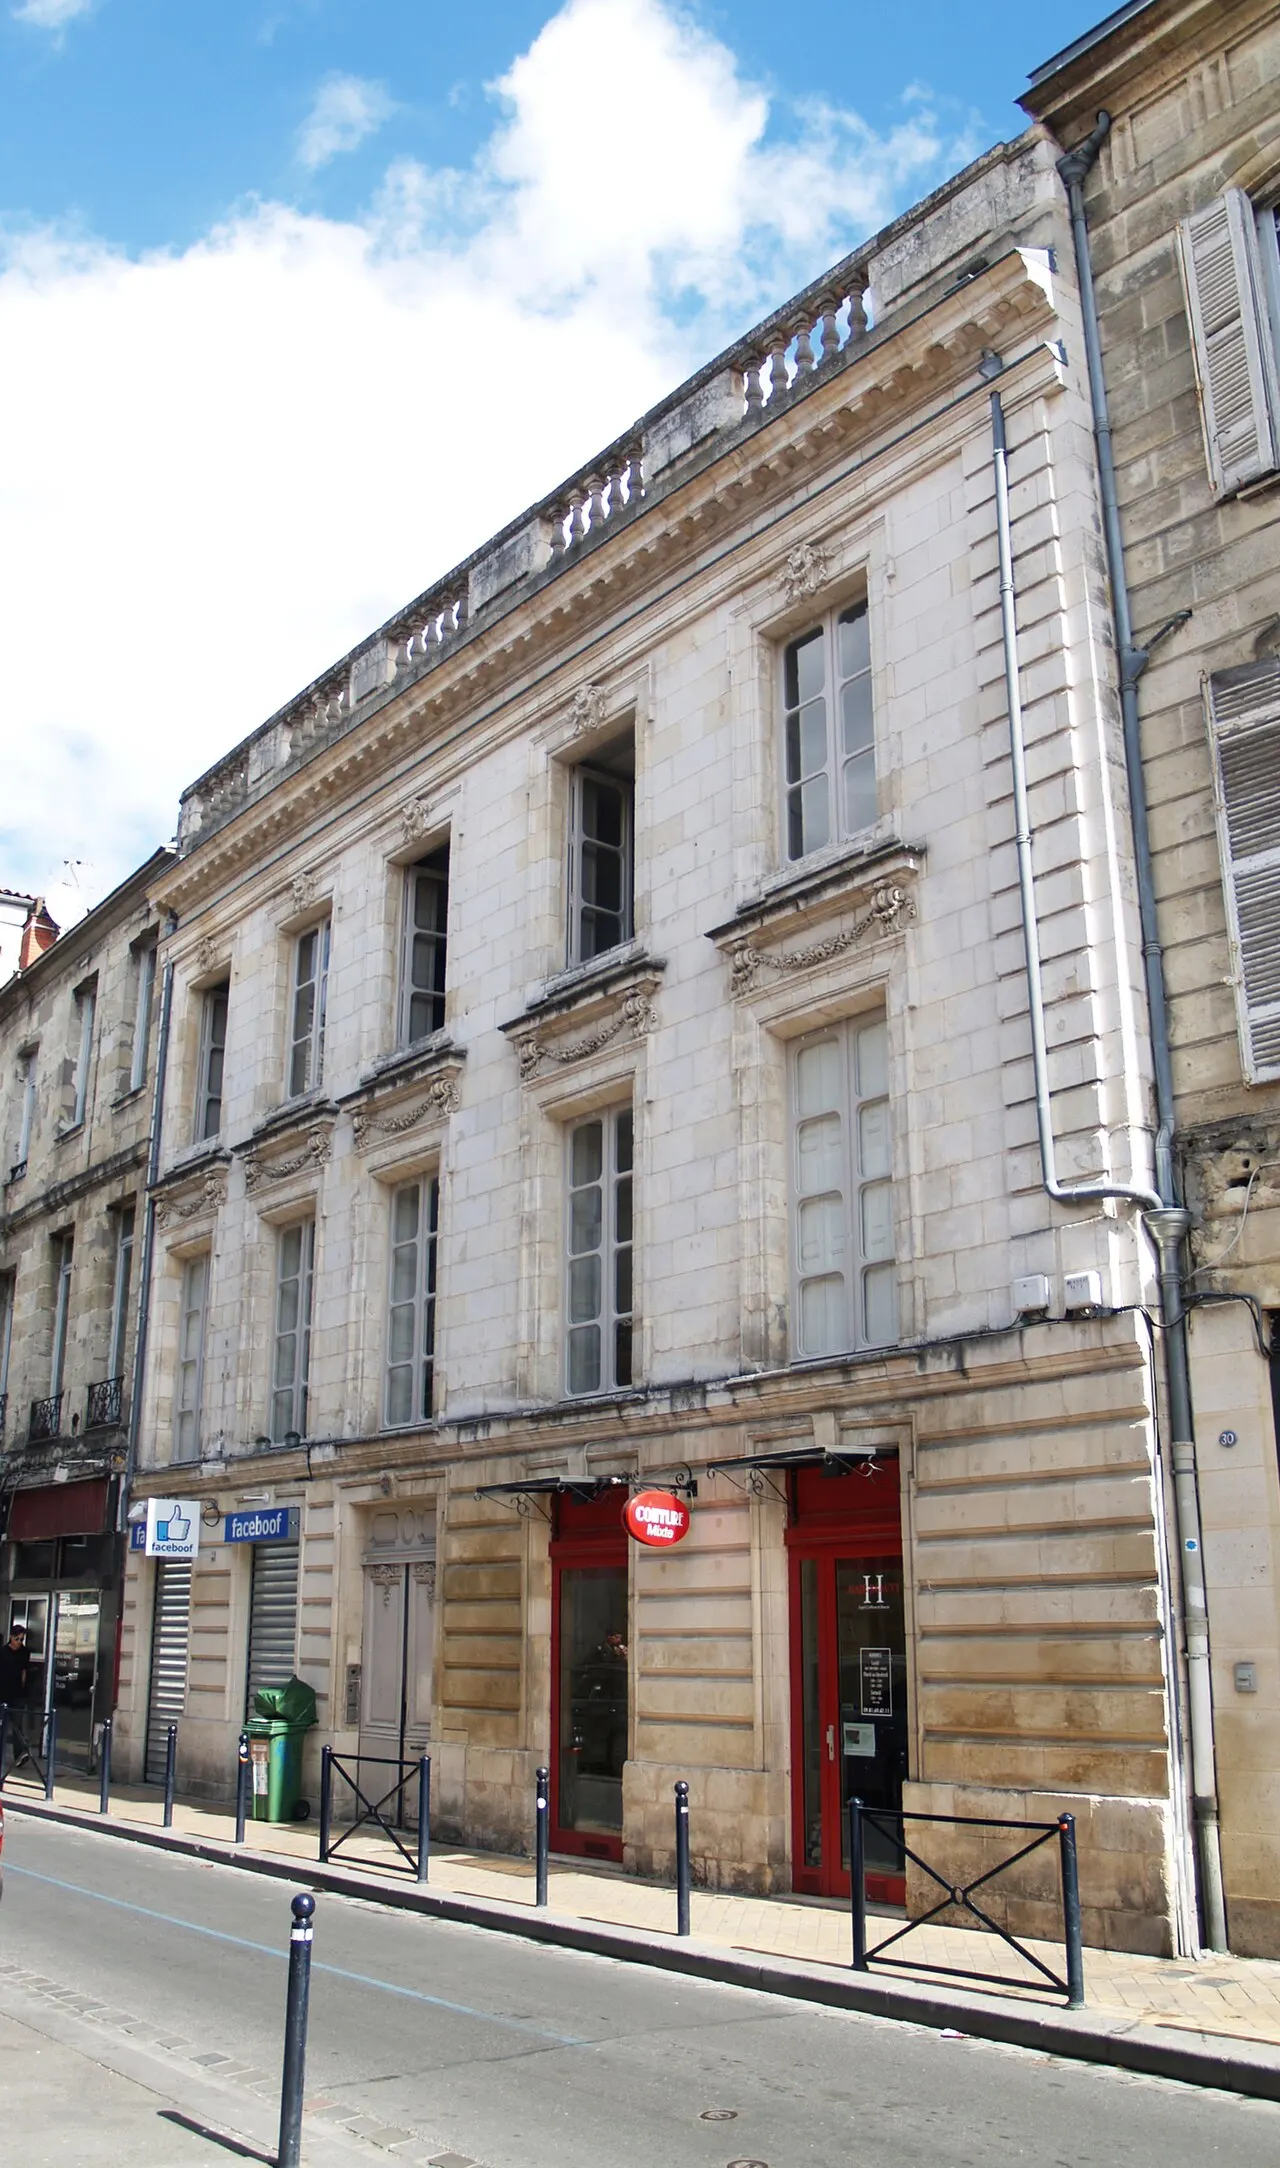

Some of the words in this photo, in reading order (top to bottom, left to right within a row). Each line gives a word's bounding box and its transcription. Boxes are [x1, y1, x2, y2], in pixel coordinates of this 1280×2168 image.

[1221, 1433, 1234, 1445] 30
[231, 1513, 282, 1538] faceboof
[646, 1523, 674, 1539] Mixte
[152, 1542, 193, 1553] faceboof
